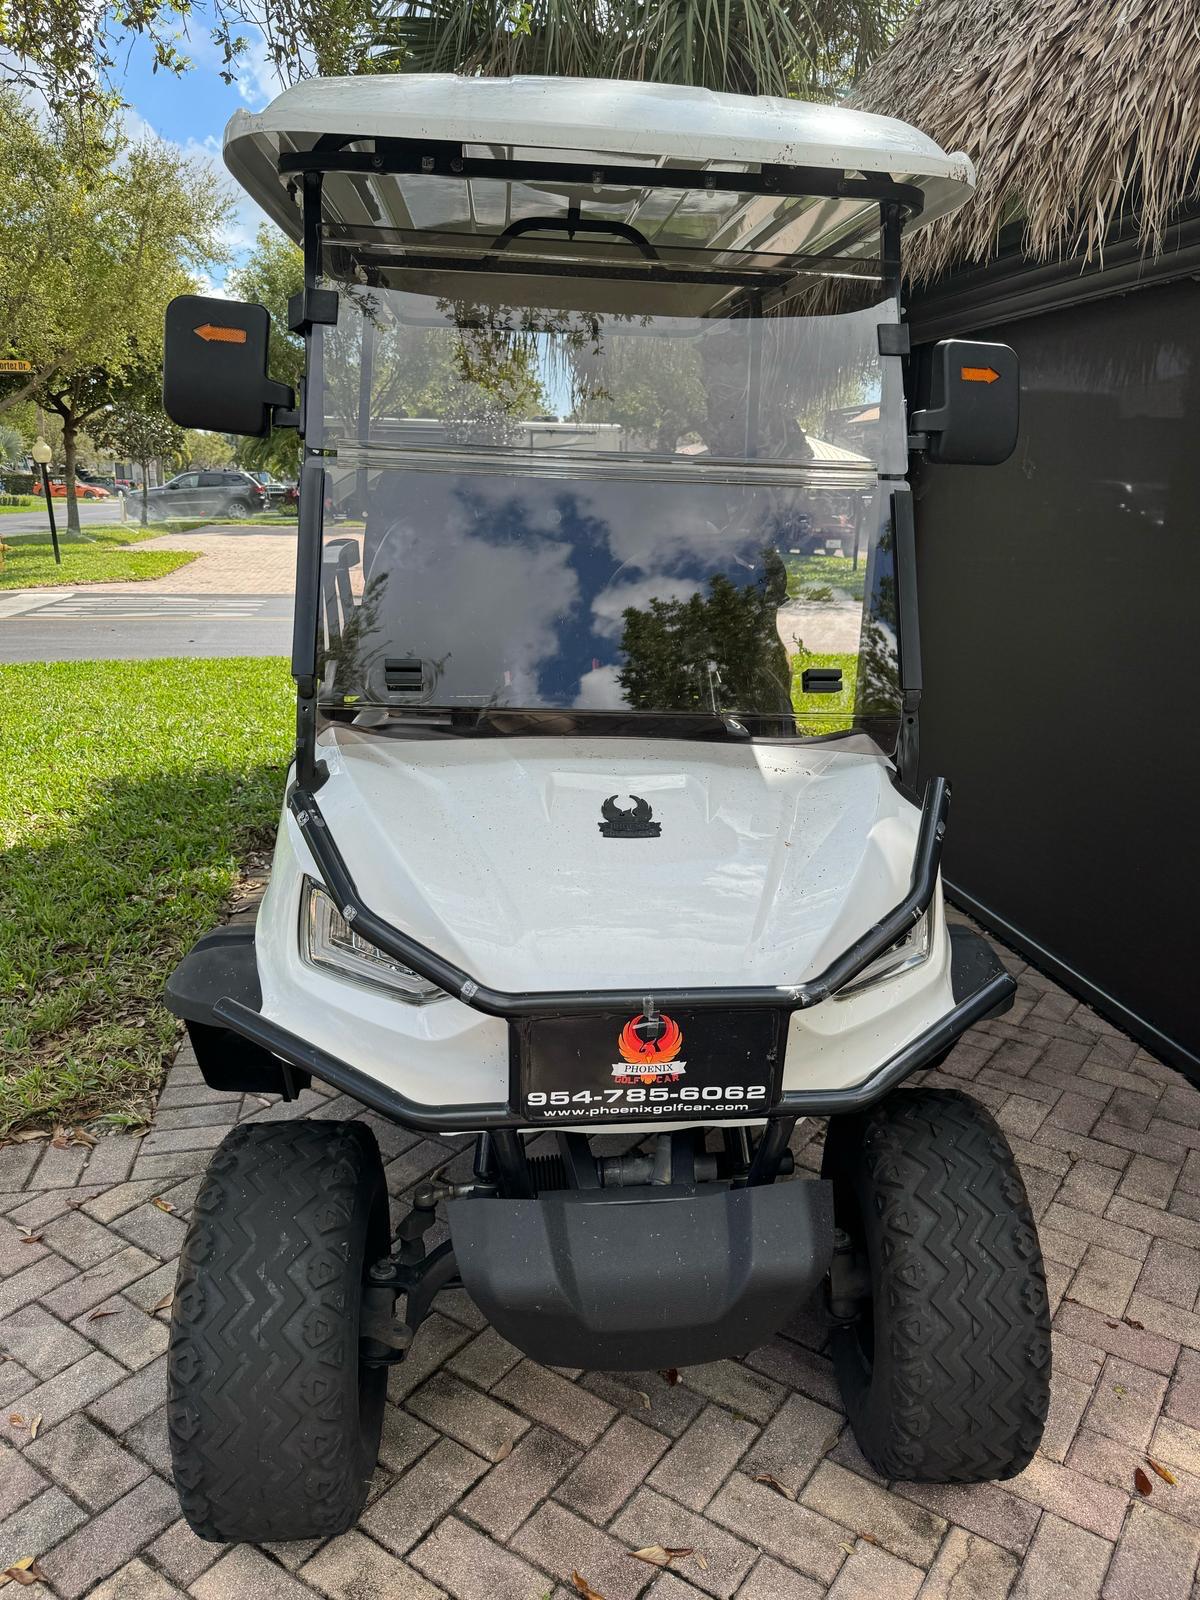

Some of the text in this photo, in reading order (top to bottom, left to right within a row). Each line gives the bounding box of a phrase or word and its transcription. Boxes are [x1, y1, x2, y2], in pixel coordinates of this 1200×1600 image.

[624, 1063, 674, 1073] PHOENIX
[614, 1072, 680, 1085] GOLF CAR
[527, 1085, 766, 1106] 954-785-6062
[543, 1103, 749, 1117] www.phoenixgolfcar.com
